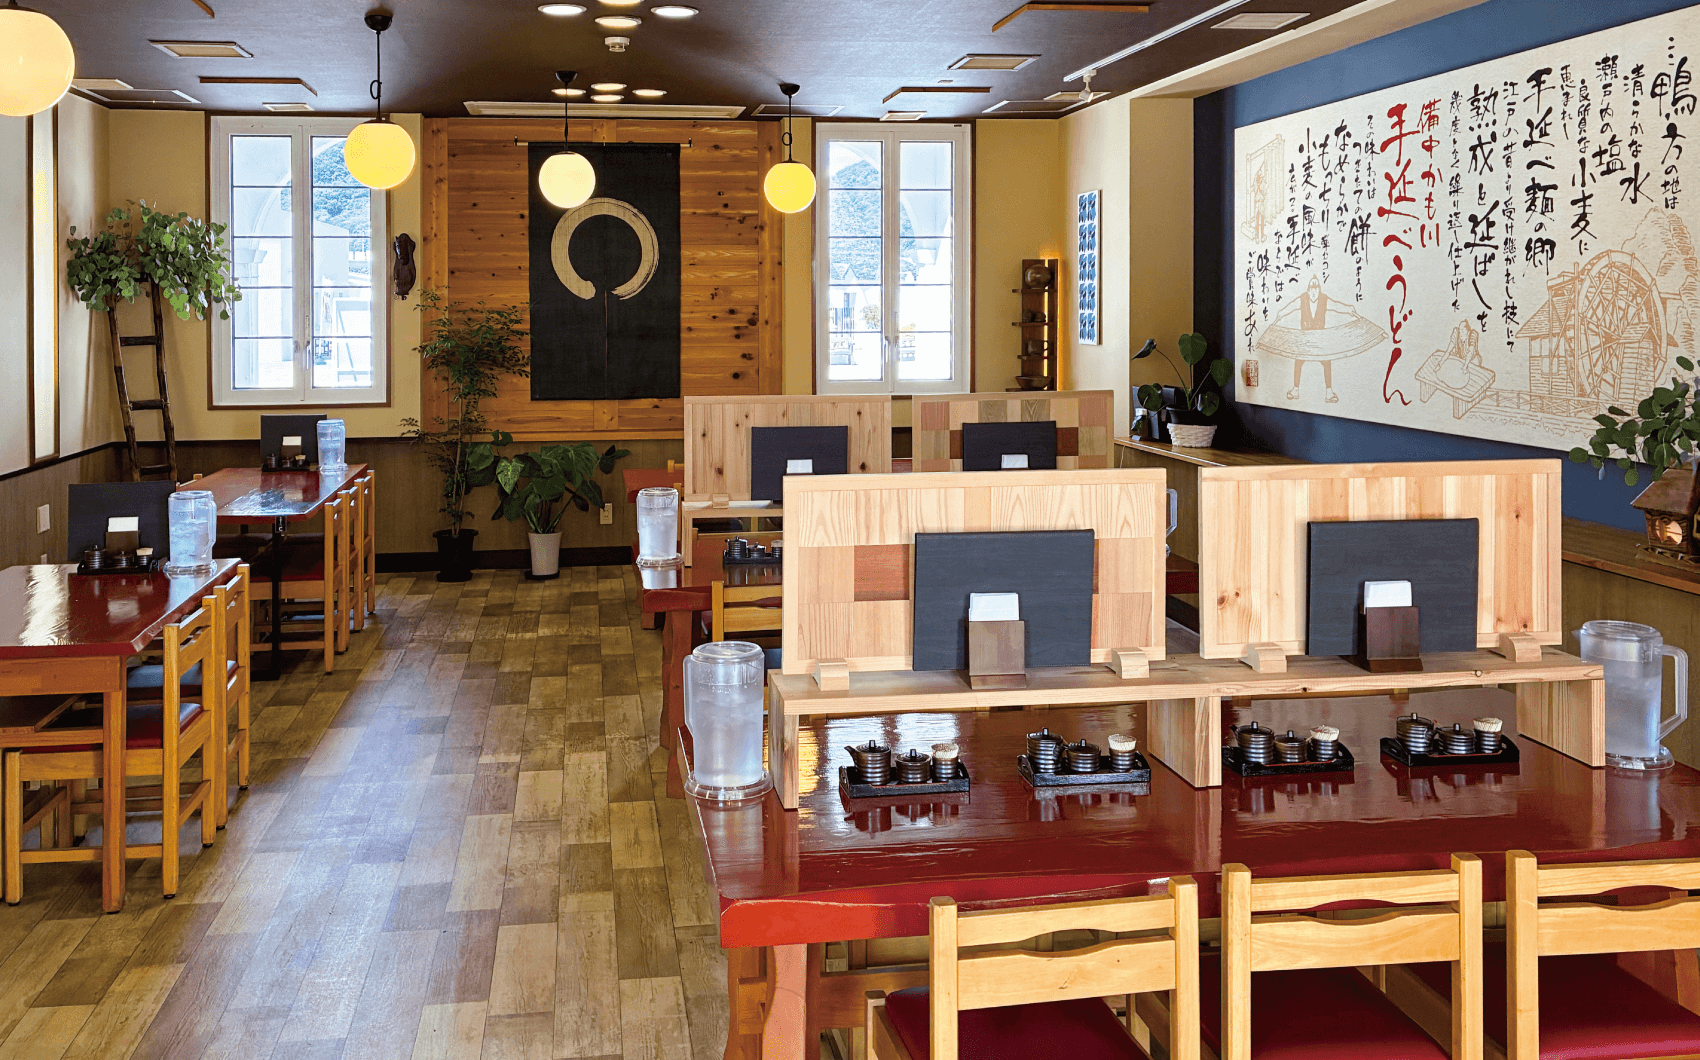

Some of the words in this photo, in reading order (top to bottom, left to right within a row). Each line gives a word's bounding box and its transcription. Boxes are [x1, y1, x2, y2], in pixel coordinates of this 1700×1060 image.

[1334, 118, 1352, 233] なめらかで
[1416, 98, 1443, 248] 備中かも川
[1570, 78, 1598, 256] 良質な小麦に
[1591, 52, 1627, 177] 瀬戸内の塩
[1619, 63, 1654, 205] 清らかな水
[1299, 127, 1321, 268] 小麦の風味が
[1377, 103, 1421, 407] 手延べうどん
[1463, 83, 1500, 333] 熟成と延ばしを
